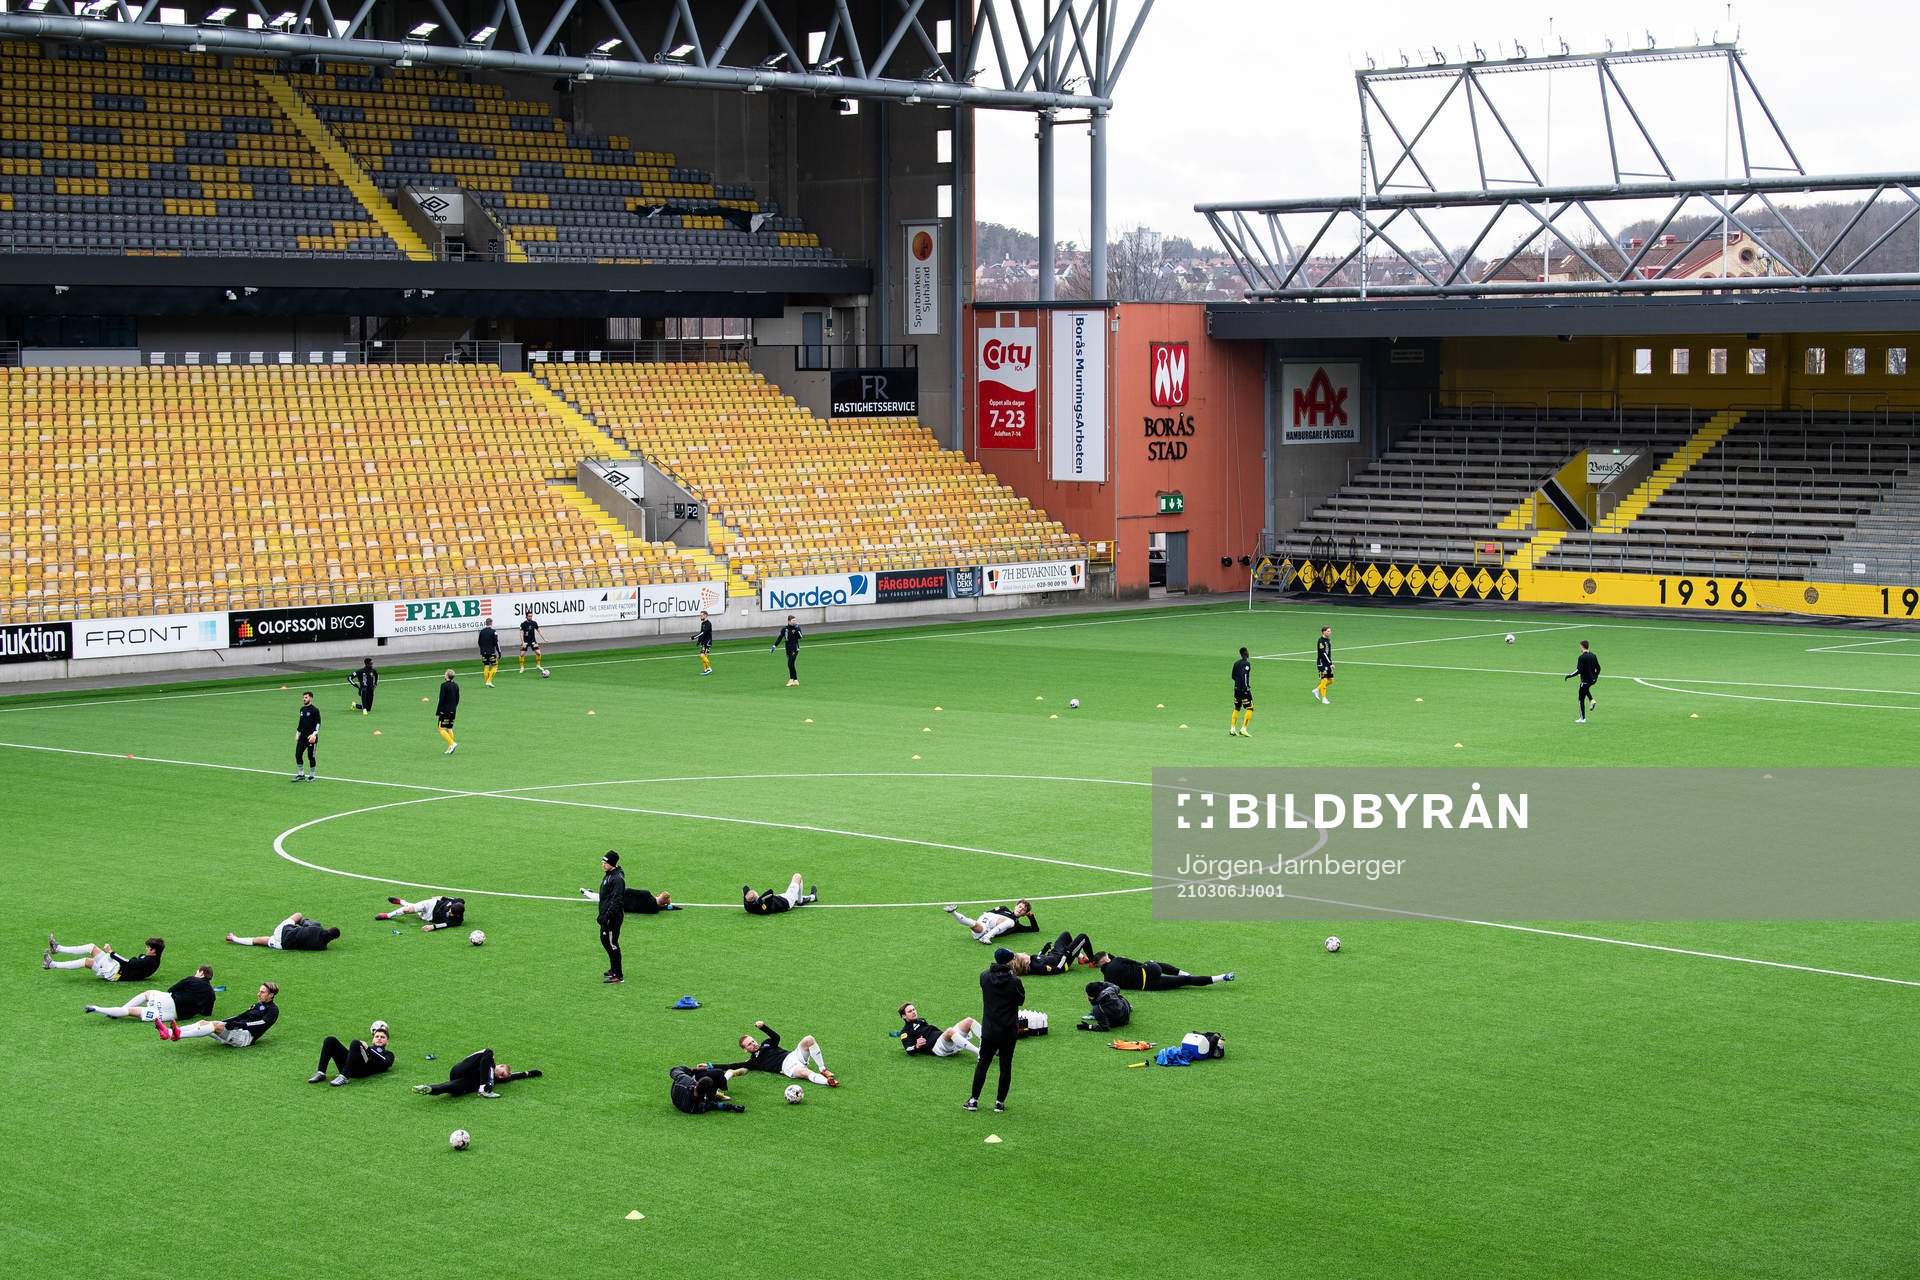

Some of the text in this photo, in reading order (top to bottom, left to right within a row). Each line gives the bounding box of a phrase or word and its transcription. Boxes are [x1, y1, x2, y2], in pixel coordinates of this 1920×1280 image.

[914, 266, 922, 328] Sparbanken
[923, 266, 931, 312] Sjuhärad
[983, 338, 1032, 371] City
[861, 375, 888, 400] FR
[1074, 317, 1085, 474] Borås MurningsArbeten
[1293, 366, 1348, 427] MAX
[834, 401, 915, 413] FASTIGHETSSERVICE
[1012, 399, 1025, 407] dagar
[989, 410, 1025, 428] 7-23
[1144, 412, 1195, 437] BORÅS
[1286, 429, 1354, 440] HAMBURGARE PÅ SVENSKA
[1148, 441, 1188, 461] STAD
[1588, 461, 1613, 473] Borås
[687, 505, 698, 517] P2
[956, 572, 972, 581] DEMI
[1002, 565, 1067, 580] 7H BEVAKNING
[878, 575, 945, 591] FÄRGBOLAGET
[956, 580, 973, 588] DEKK
[770, 586, 847, 609] Nordea
[1659, 578, 1747, 607] 1936
[405, 599, 482, 622] PEAB
[514, 599, 585, 617] SIMONSLAND
[597, 603, 619, 611] CREATIVE
[619, 602, 636, 610] FACTORY
[643, 597, 701, 615] ProFlow
[258, 615, 365, 635] OLOFSSON BYGG
[394, 625, 426, 633] NORDENS
[86, 625, 188, 647] FRONT
